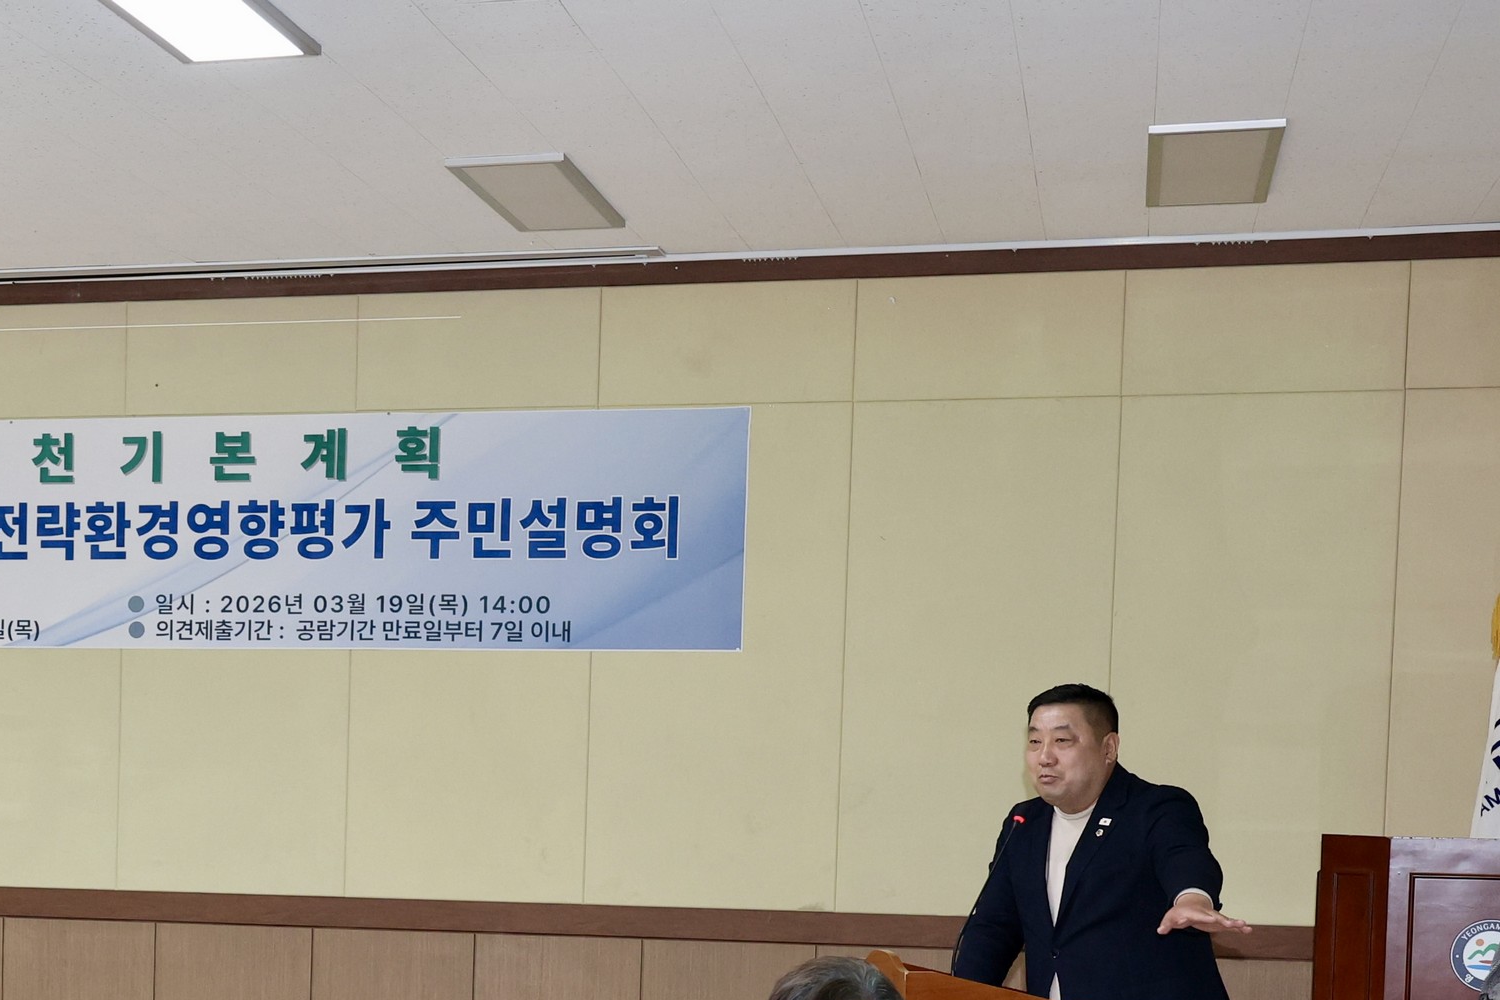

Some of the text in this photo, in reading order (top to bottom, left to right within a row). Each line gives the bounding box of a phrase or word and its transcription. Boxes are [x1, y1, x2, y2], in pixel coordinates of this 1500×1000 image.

[411, 496, 678, 559] 주민설명회
[156, 594, 194, 615] 일시
[221, 593, 302, 614] 2026년
[314, 593, 365, 615] 03월
[377, 593, 468, 617] 19일(목)
[480, 596, 550, 614] 14:00
[296, 620, 376, 641] 공람기간
[383, 620, 482, 642] 만료일부터
[491, 620, 522, 642] 7일
[531, 621, 571, 643] 이내
